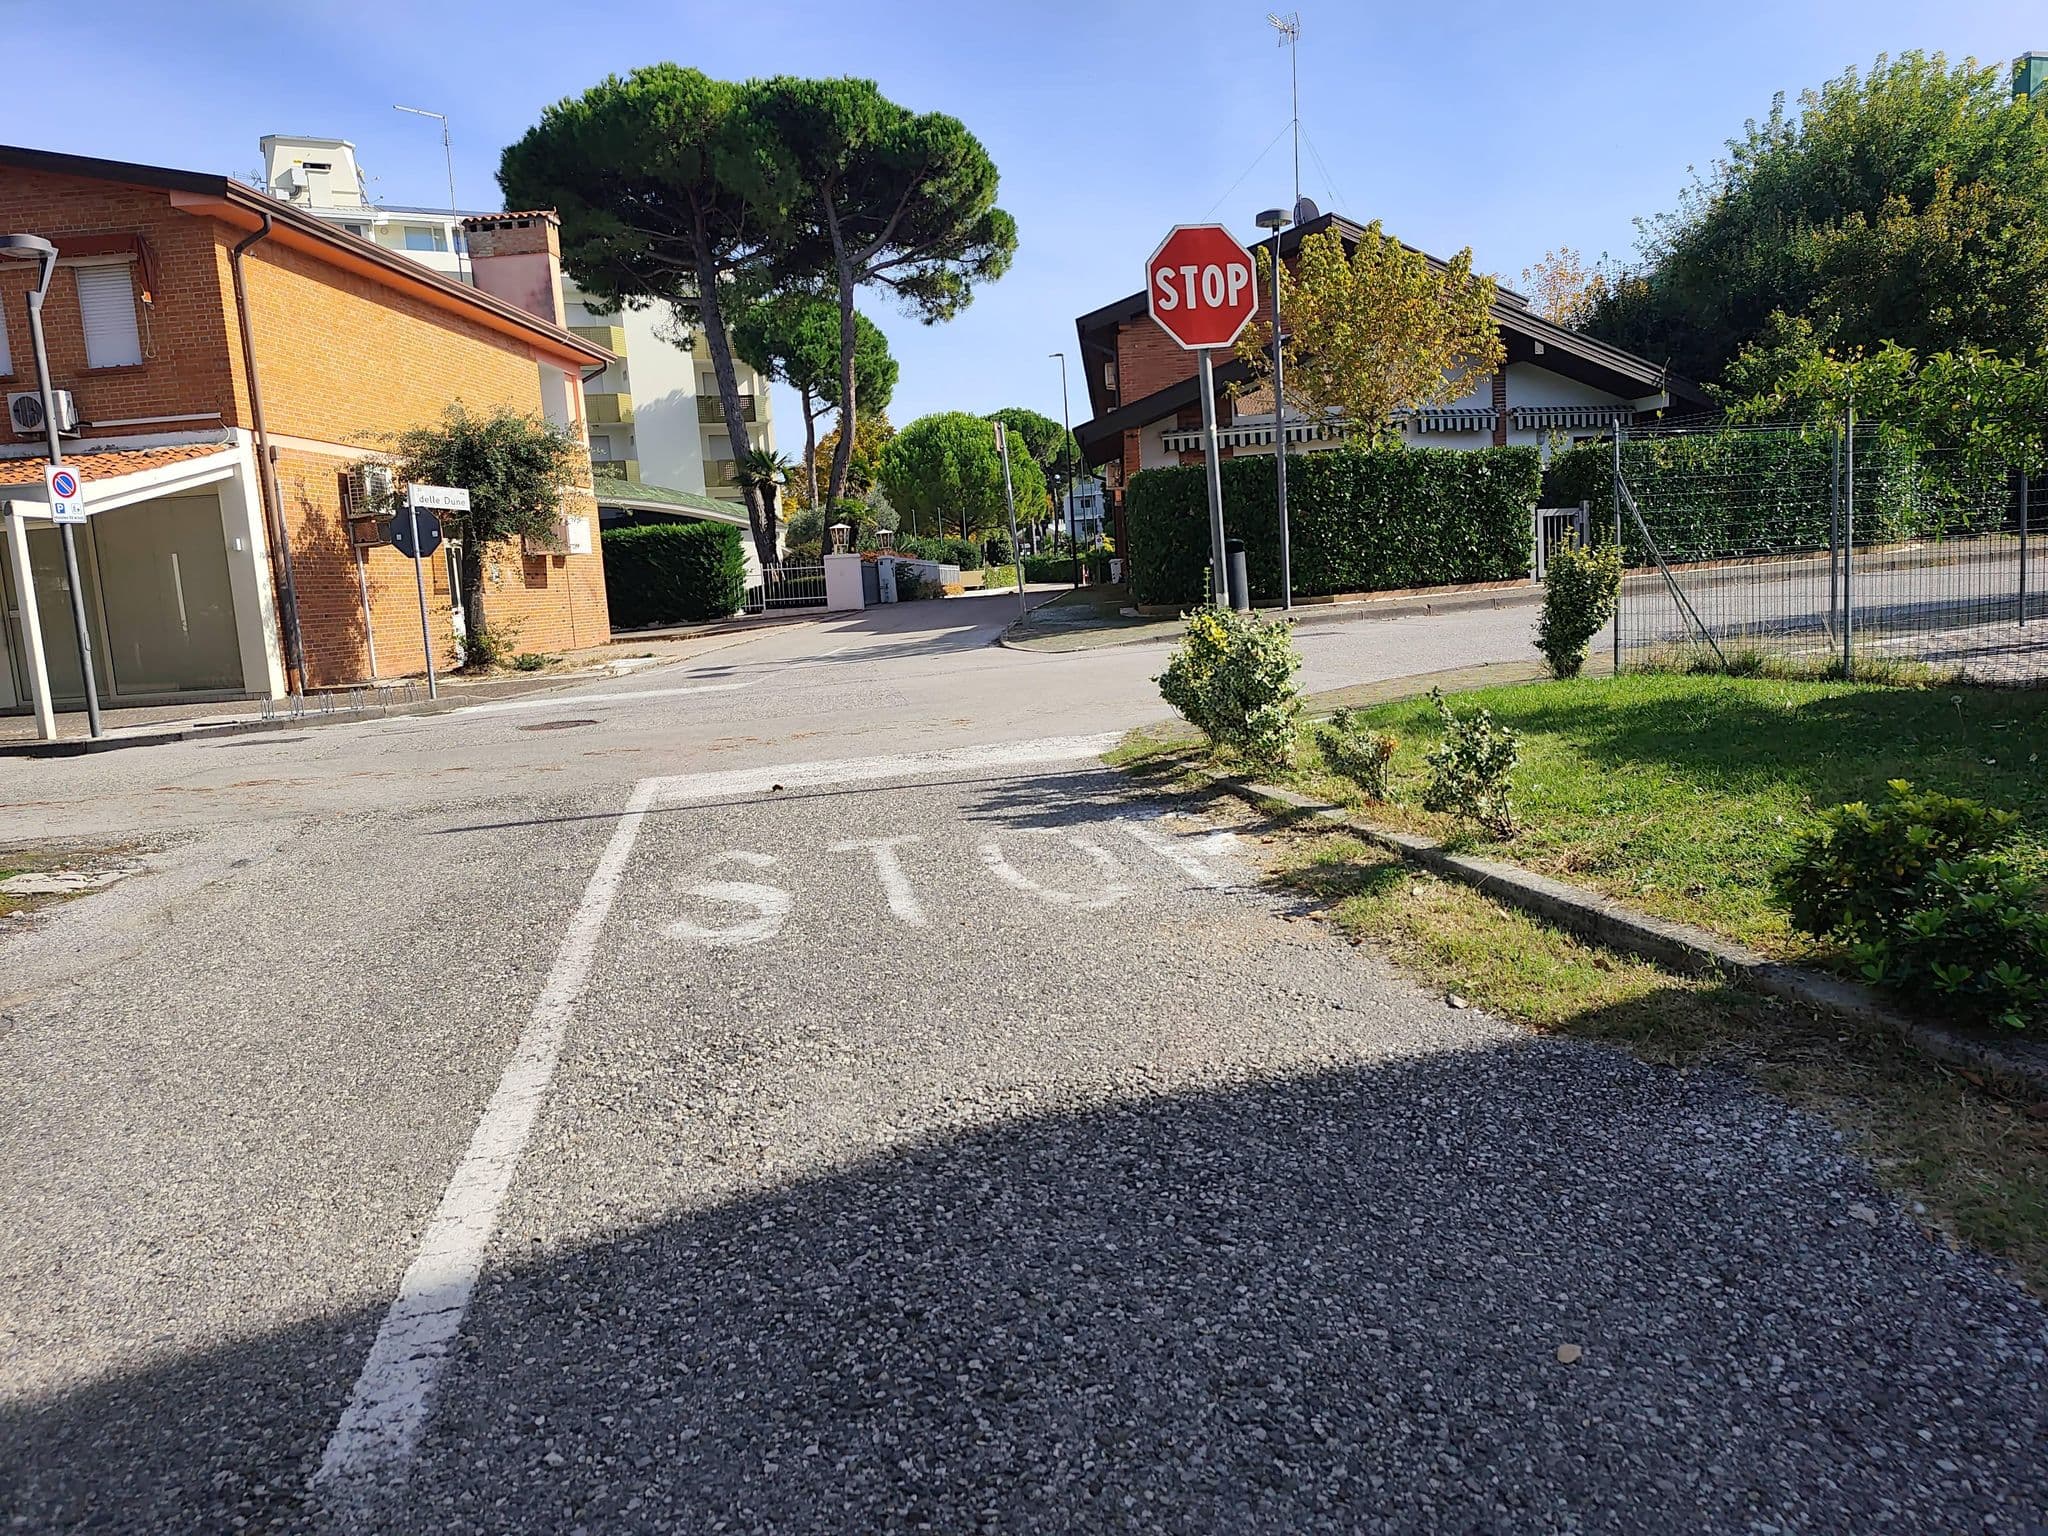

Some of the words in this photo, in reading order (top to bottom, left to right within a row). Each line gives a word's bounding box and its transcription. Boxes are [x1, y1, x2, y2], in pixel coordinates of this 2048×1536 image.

[1155, 263, 1248, 310] STOP
[418, 495, 440, 504] delle
[444, 496, 466, 506] Dune
